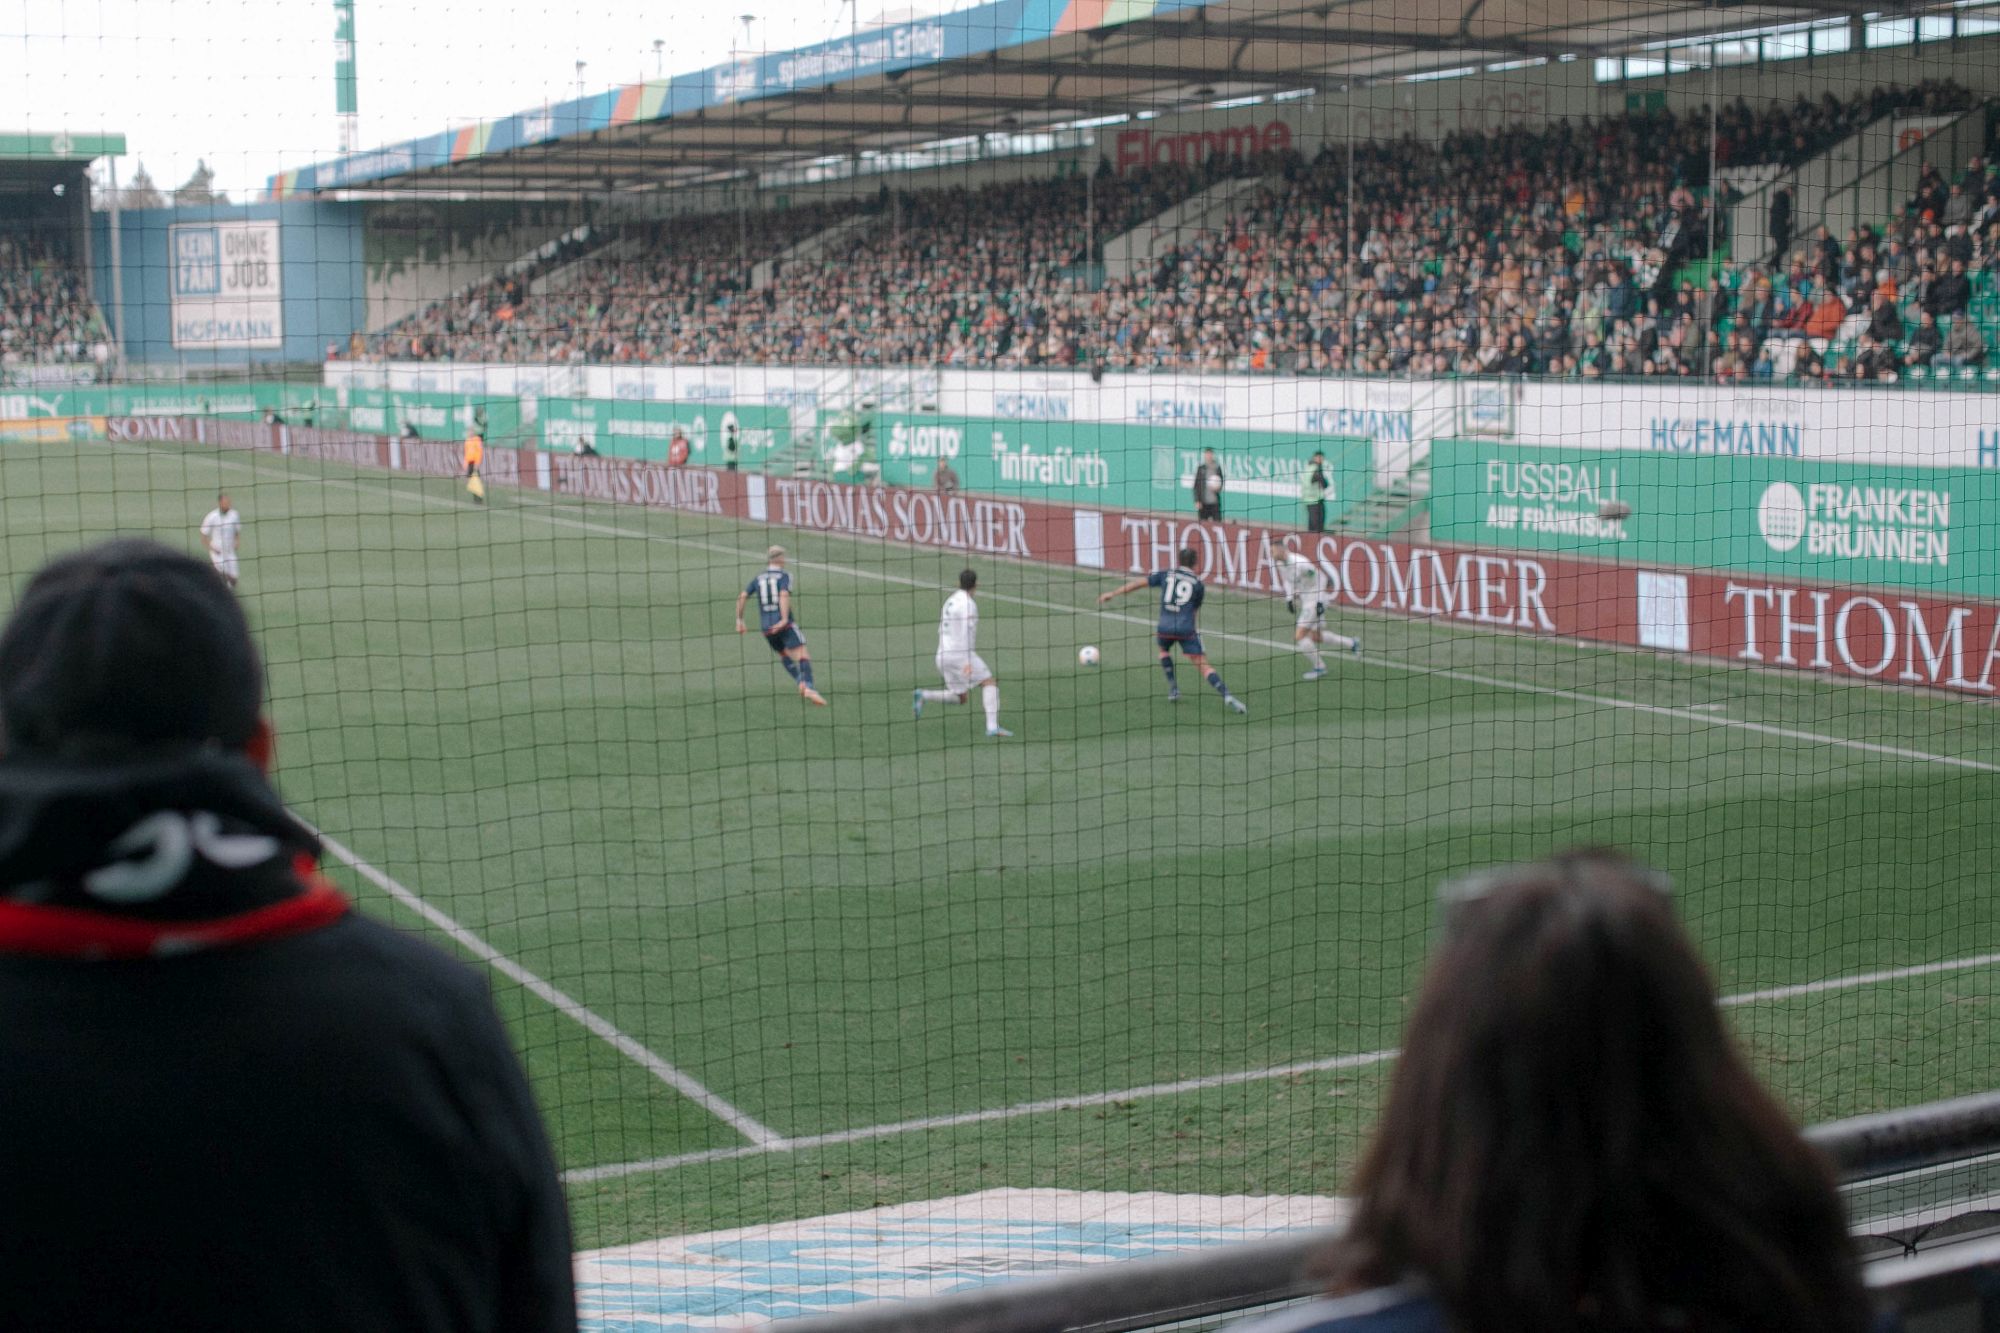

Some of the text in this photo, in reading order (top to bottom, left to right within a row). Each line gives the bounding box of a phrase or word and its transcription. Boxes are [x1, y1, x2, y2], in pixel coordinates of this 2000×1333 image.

[225, 230, 268, 256] OHNE
[910, 426, 962, 458] LOTTO
[1650, 416, 1799, 457] HOFMANN
[1002, 443, 1109, 489] infrafürth
[1487, 459, 1618, 506] FUSSBALL
[632, 466, 722, 514] SOMMER
[1808, 483, 1950, 527] FRANKEN
[776, 479, 1032, 557] THOMAS SOMMER
[1487, 504, 1519, 530] AUF
[1807, 521, 1949, 566] BRUNNEN
[758, 577, 780, 605] 11
[1164, 576, 1194, 606] 19
[1316, 535, 1556, 632] SOMMER
